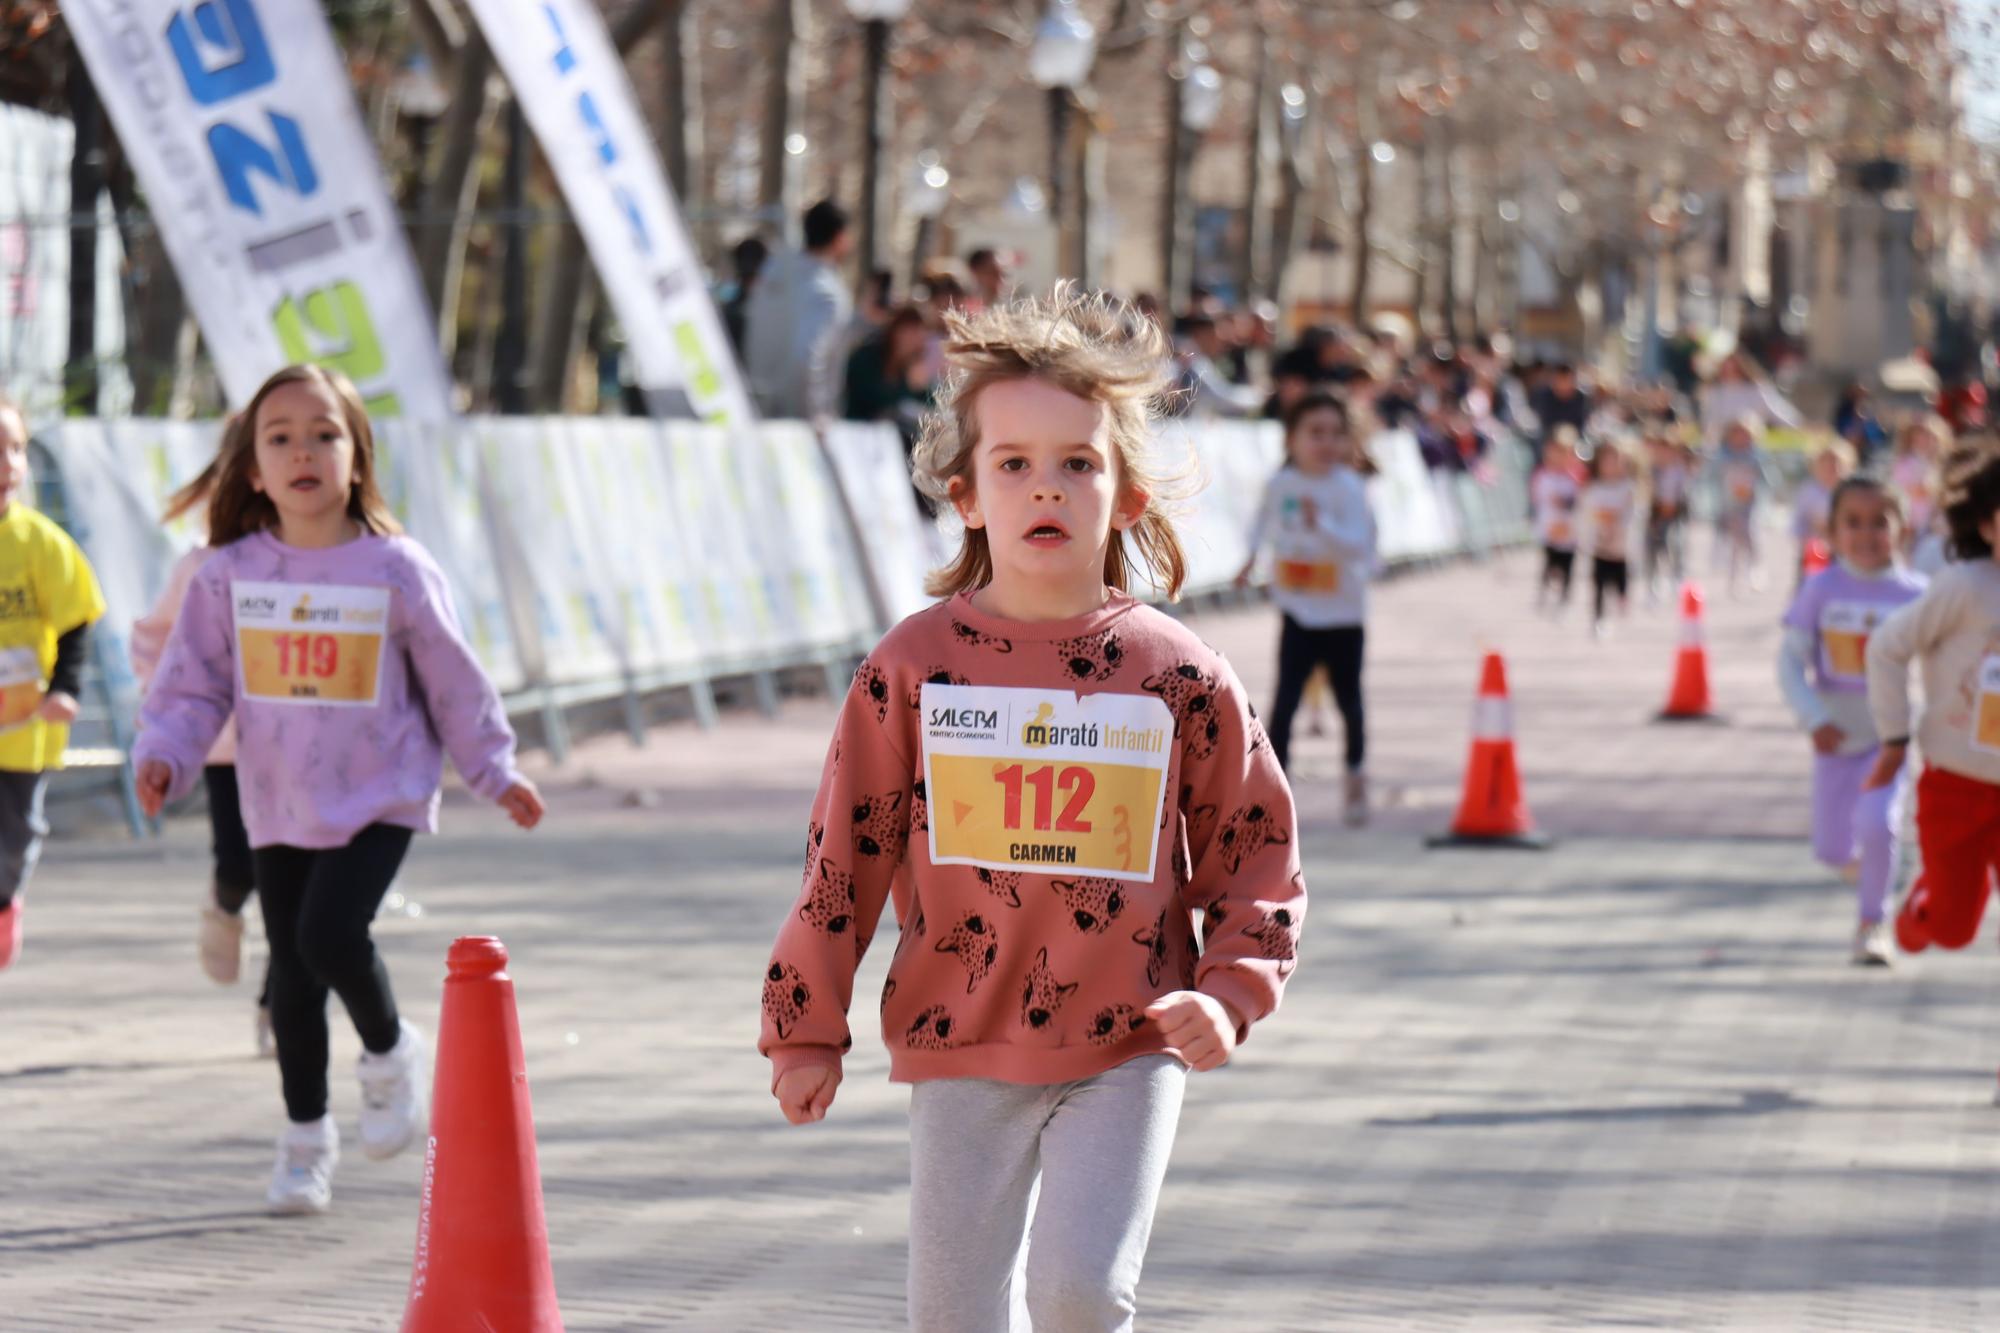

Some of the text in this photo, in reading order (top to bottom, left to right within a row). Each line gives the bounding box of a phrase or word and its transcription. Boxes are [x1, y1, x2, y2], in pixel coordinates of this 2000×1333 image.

[273, 632, 339, 678] 119
[929, 708, 998, 729] SALERA
[1026, 720, 1164, 754] marató Infantil
[994, 764, 1096, 833] 112
[1010, 843, 1076, 863] CARMEN
